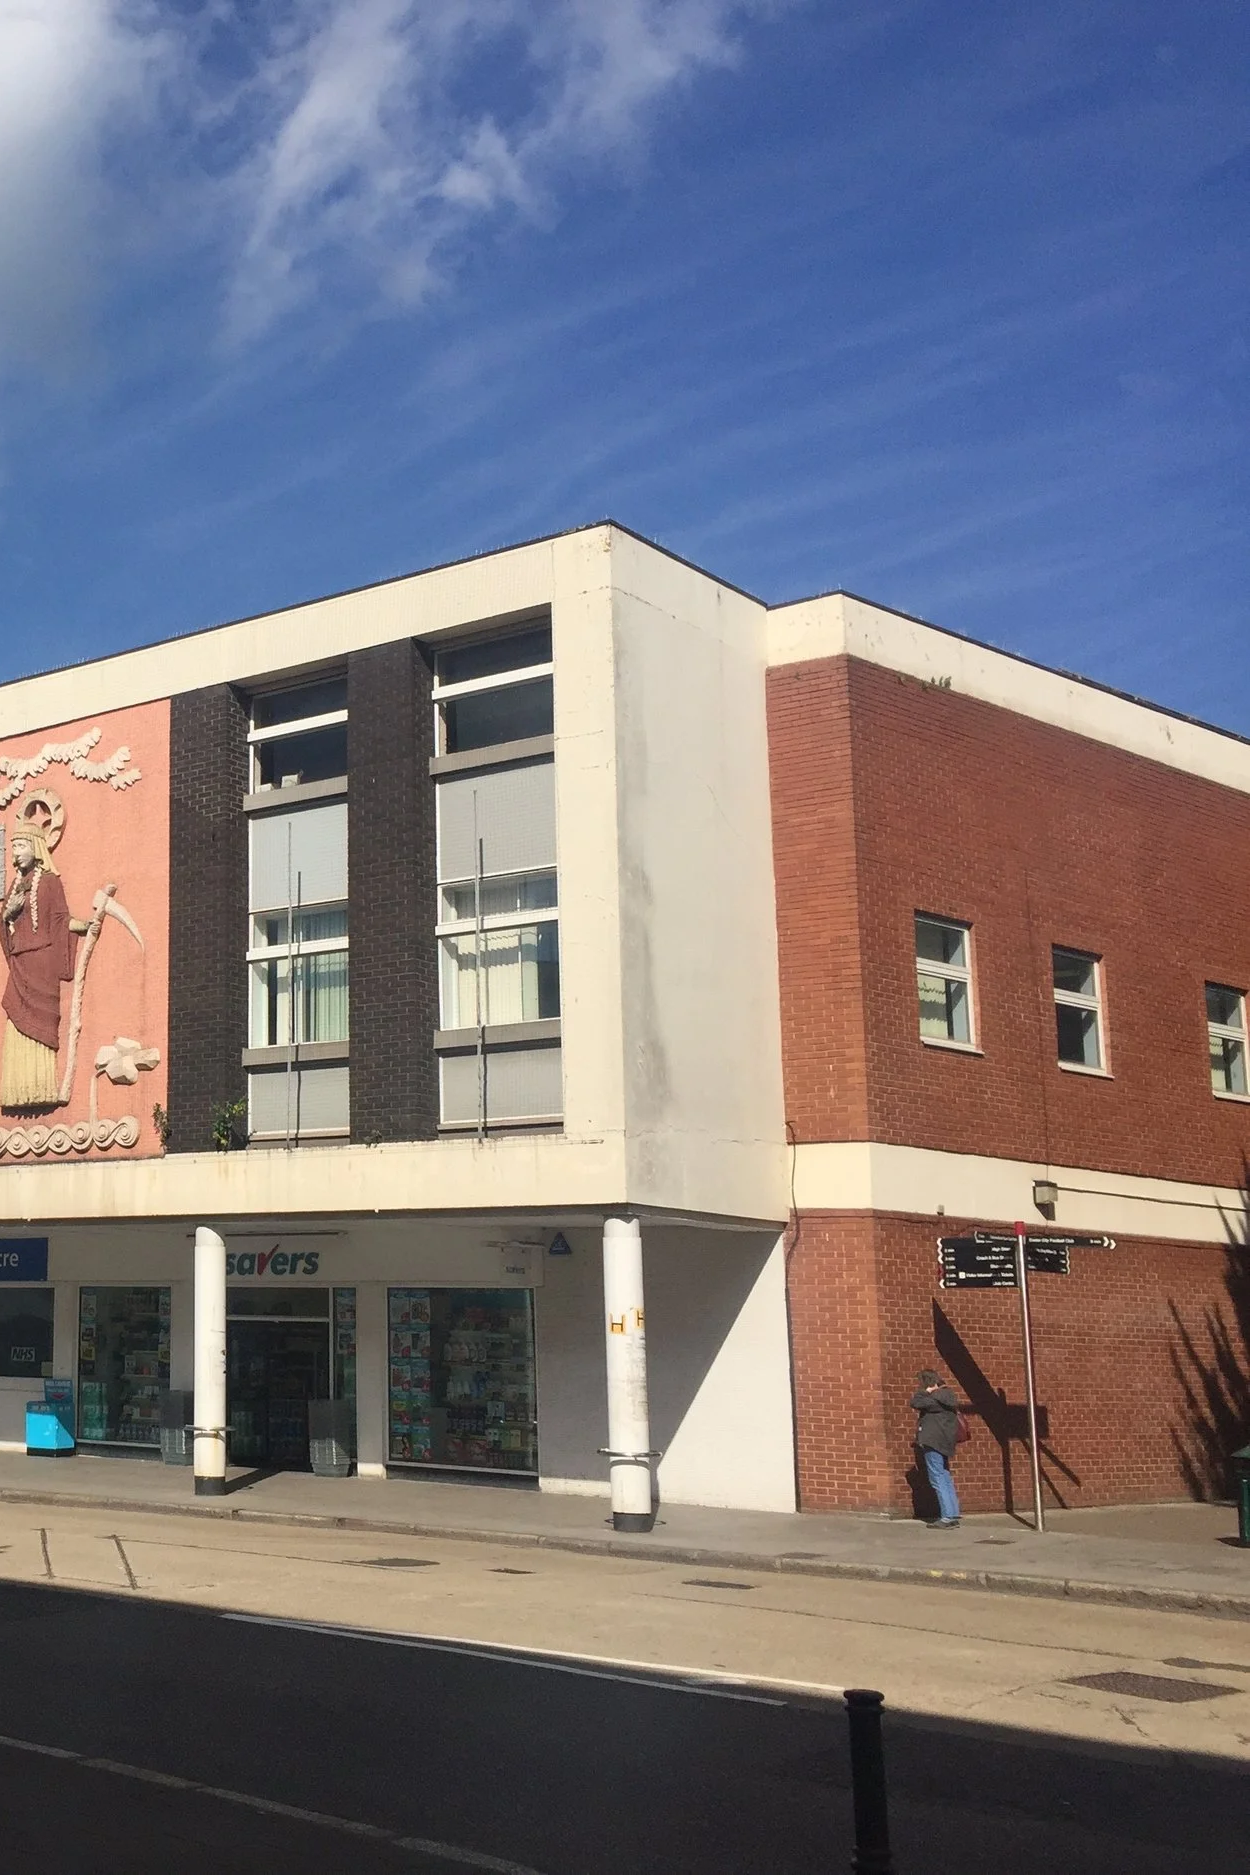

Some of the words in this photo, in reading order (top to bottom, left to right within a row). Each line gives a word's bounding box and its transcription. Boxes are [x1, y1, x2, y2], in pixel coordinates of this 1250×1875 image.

[226, 1243, 320, 1276] savers
[609, 1313, 624, 1332] H
[13, 1347, 34, 1359] NHS
